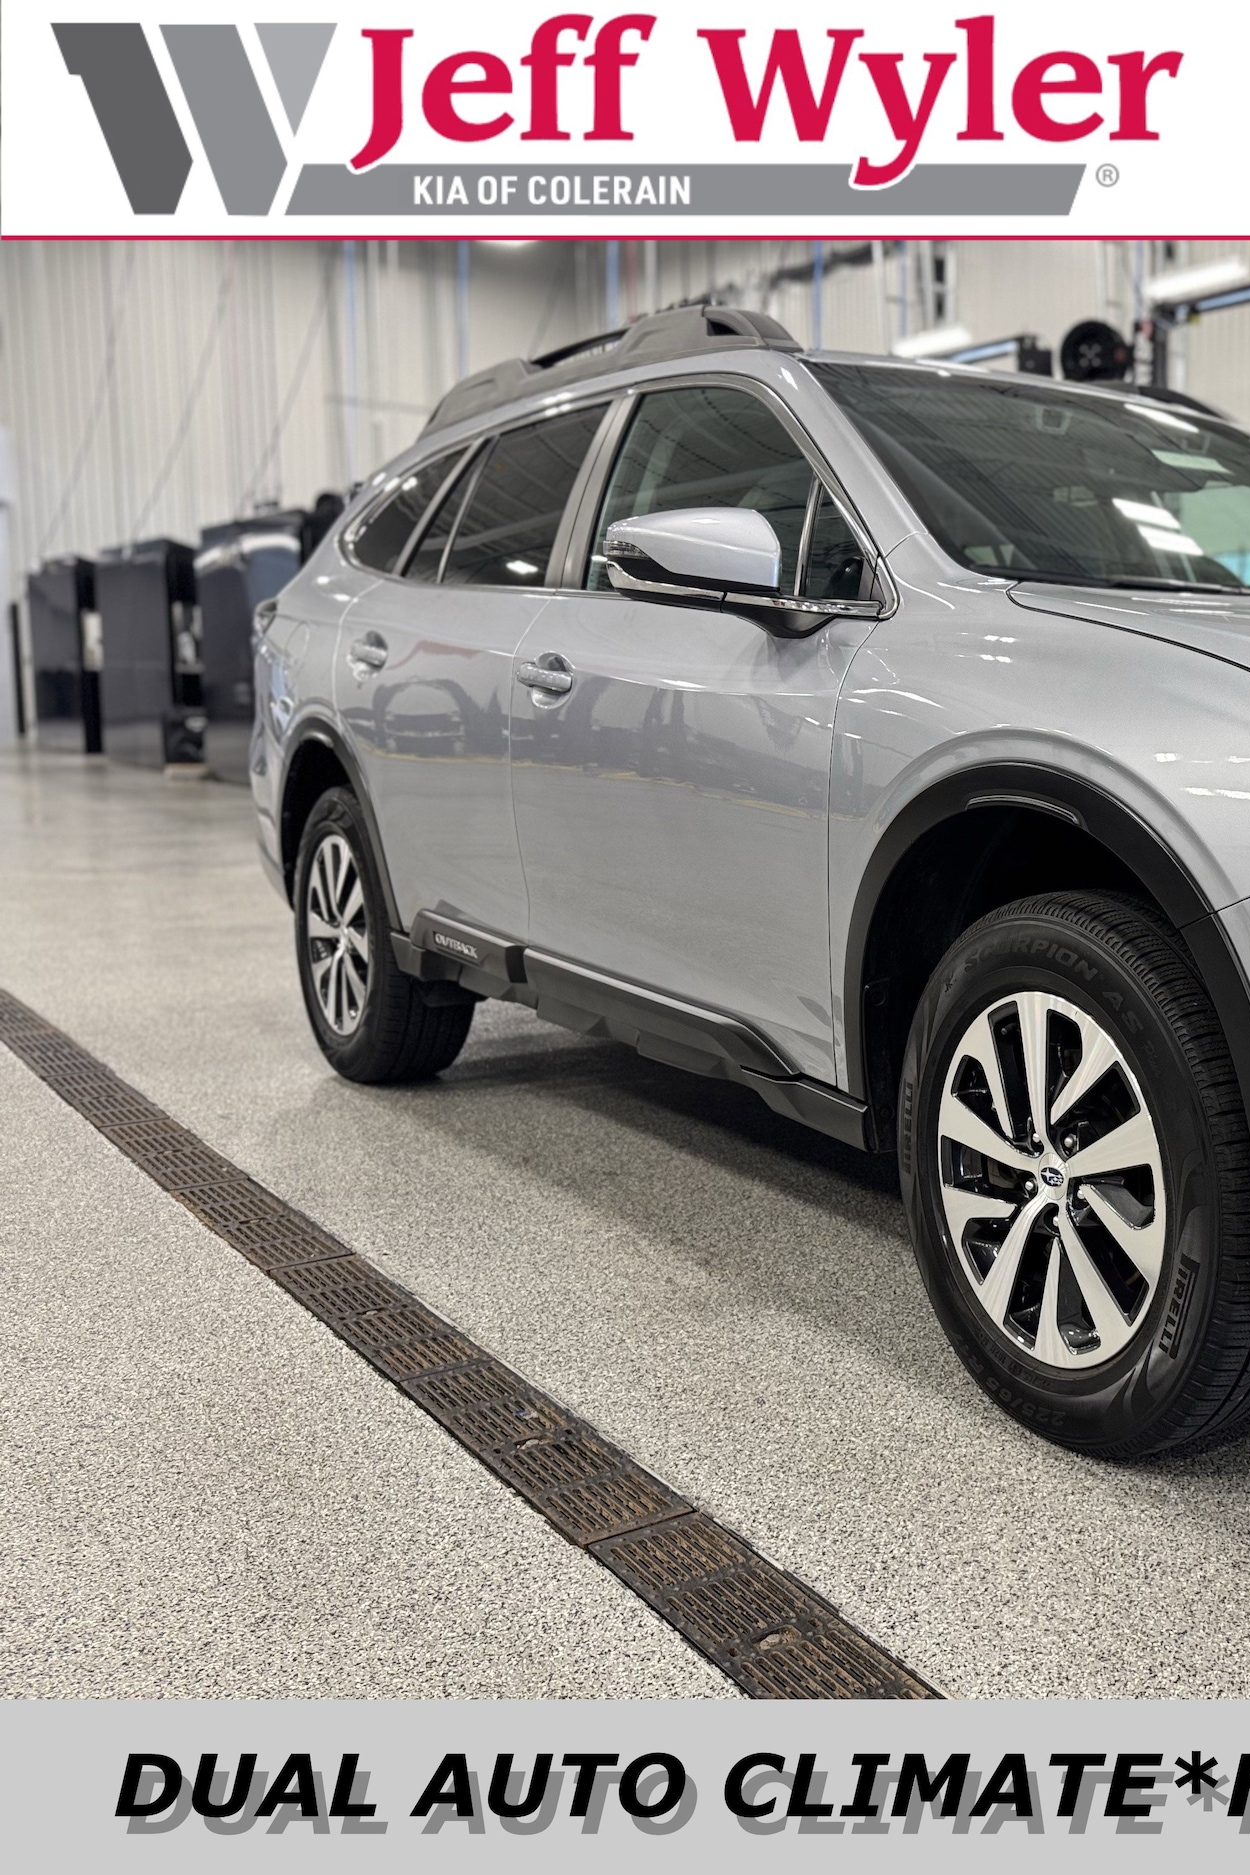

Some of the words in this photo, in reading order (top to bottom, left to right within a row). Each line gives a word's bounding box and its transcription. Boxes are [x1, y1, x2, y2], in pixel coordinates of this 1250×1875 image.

[434, 932, 479, 959] OUTBACK
[965, 935, 1099, 981] SCORPION
[1158, 1252, 1201, 1360] PIRELLI
